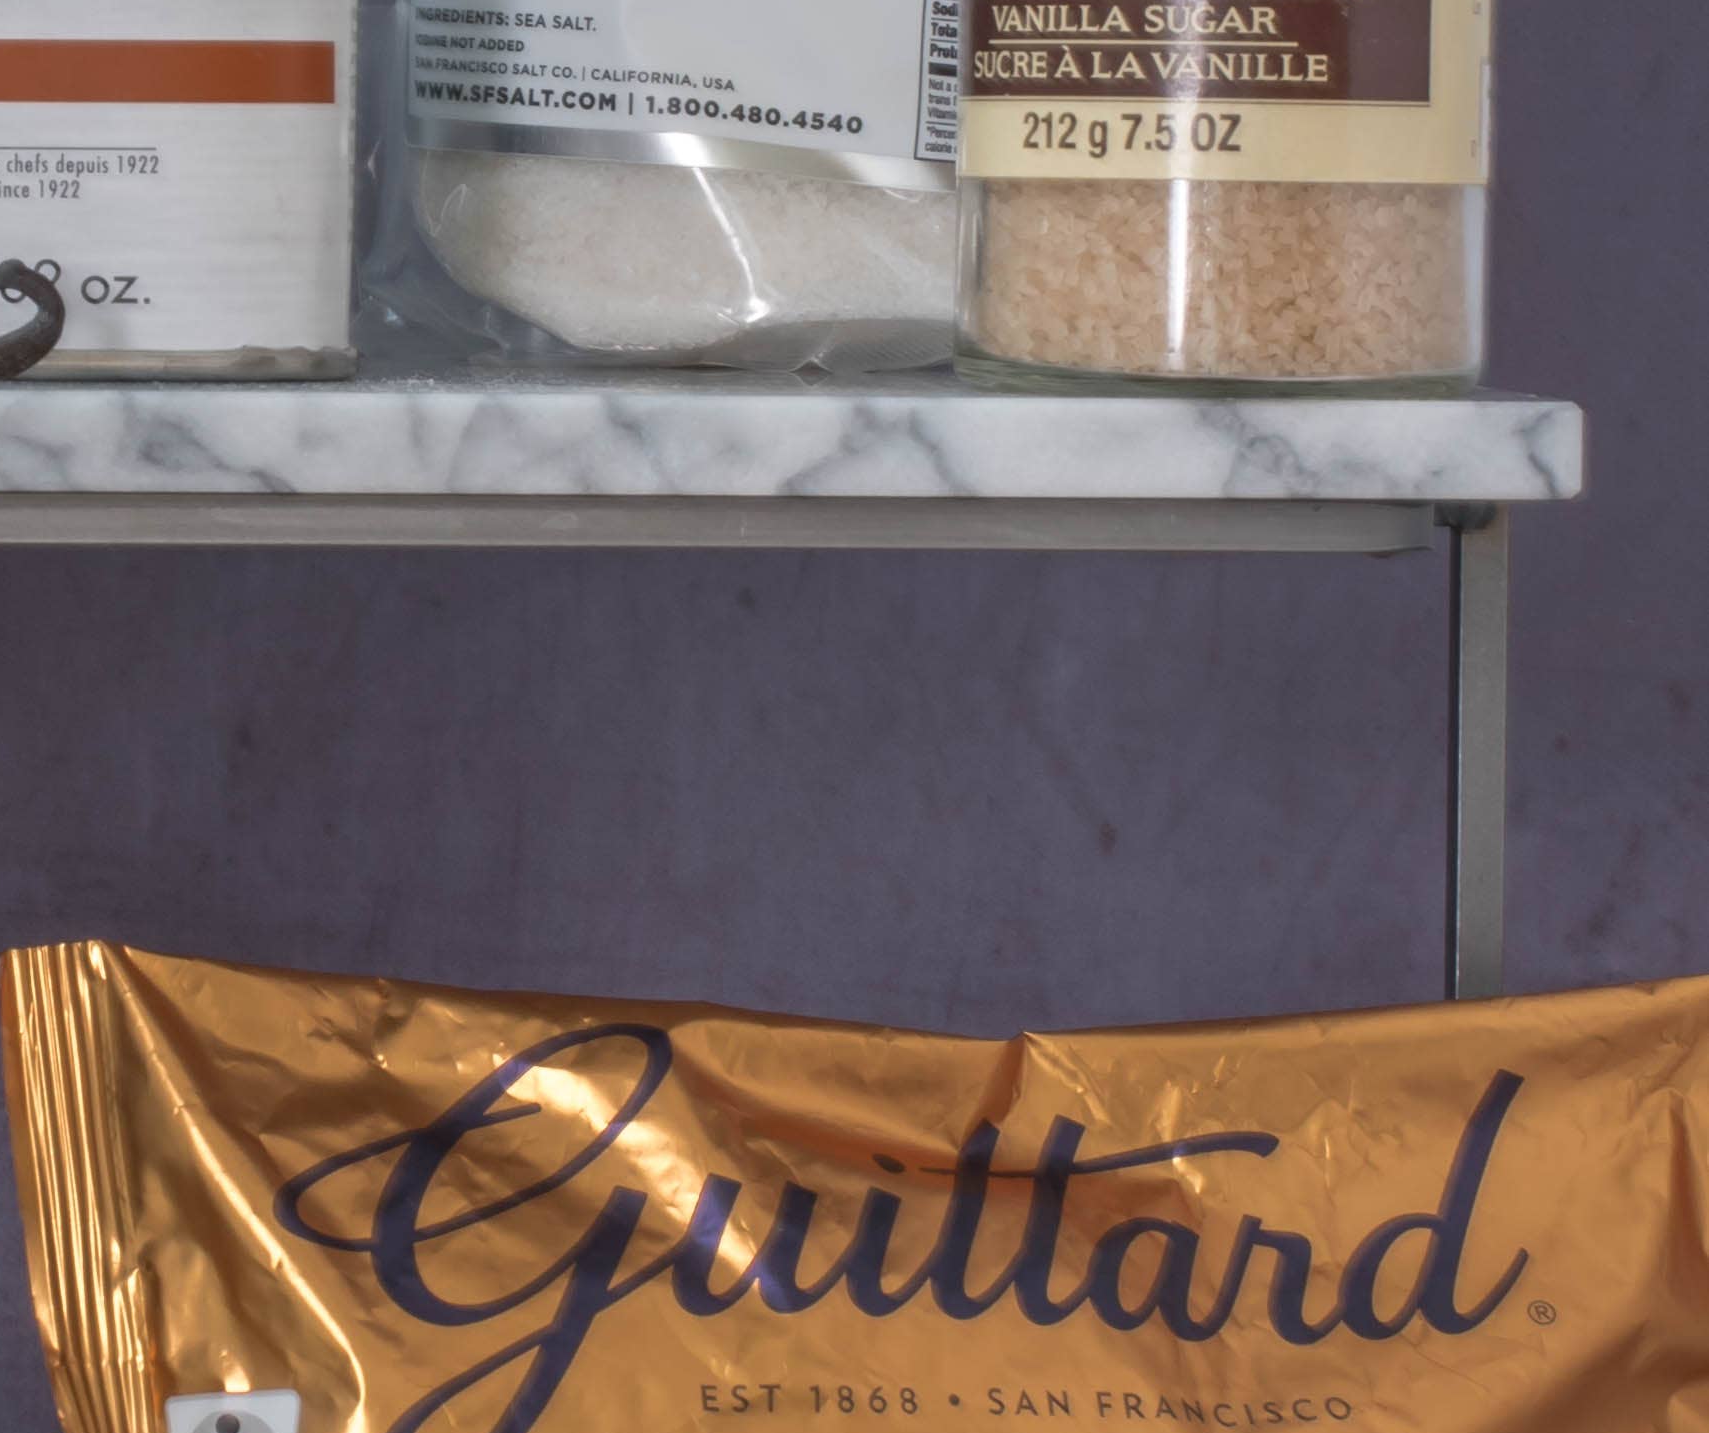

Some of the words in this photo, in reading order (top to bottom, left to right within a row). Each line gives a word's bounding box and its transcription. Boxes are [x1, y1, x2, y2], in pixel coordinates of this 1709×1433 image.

[992, 5, 1129, 34] VANILLA
[1145, 5, 1278, 35] SUGAR
[974, 50, 1047, 79] SUCRE
[1090, 52, 1146, 80] LA
[1150, 52, 1329, 82] VANILLE
[415, 79, 617, 112] WWW.SFSALT.COM
[646, 95, 863, 135] 1.800.480.4540
[1023, 113, 1077, 150] 212
[1089, 121, 1109, 157] g
[1121, 114, 1176, 151] 7.5
[1191, 114, 1242, 152] OZ
[6, 154, 49, 173] chefs
[56, 154, 109, 177] depuis
[118, 155, 160, 174] 1922
[39, 180, 81, 199] 1922
[701, 1384, 781, 1414] EST
[810, 1386, 919, 1415] 1868
[987, 1388, 1071, 1418] SAN
[1096, 1391, 1352, 1428] FRANCISCO
